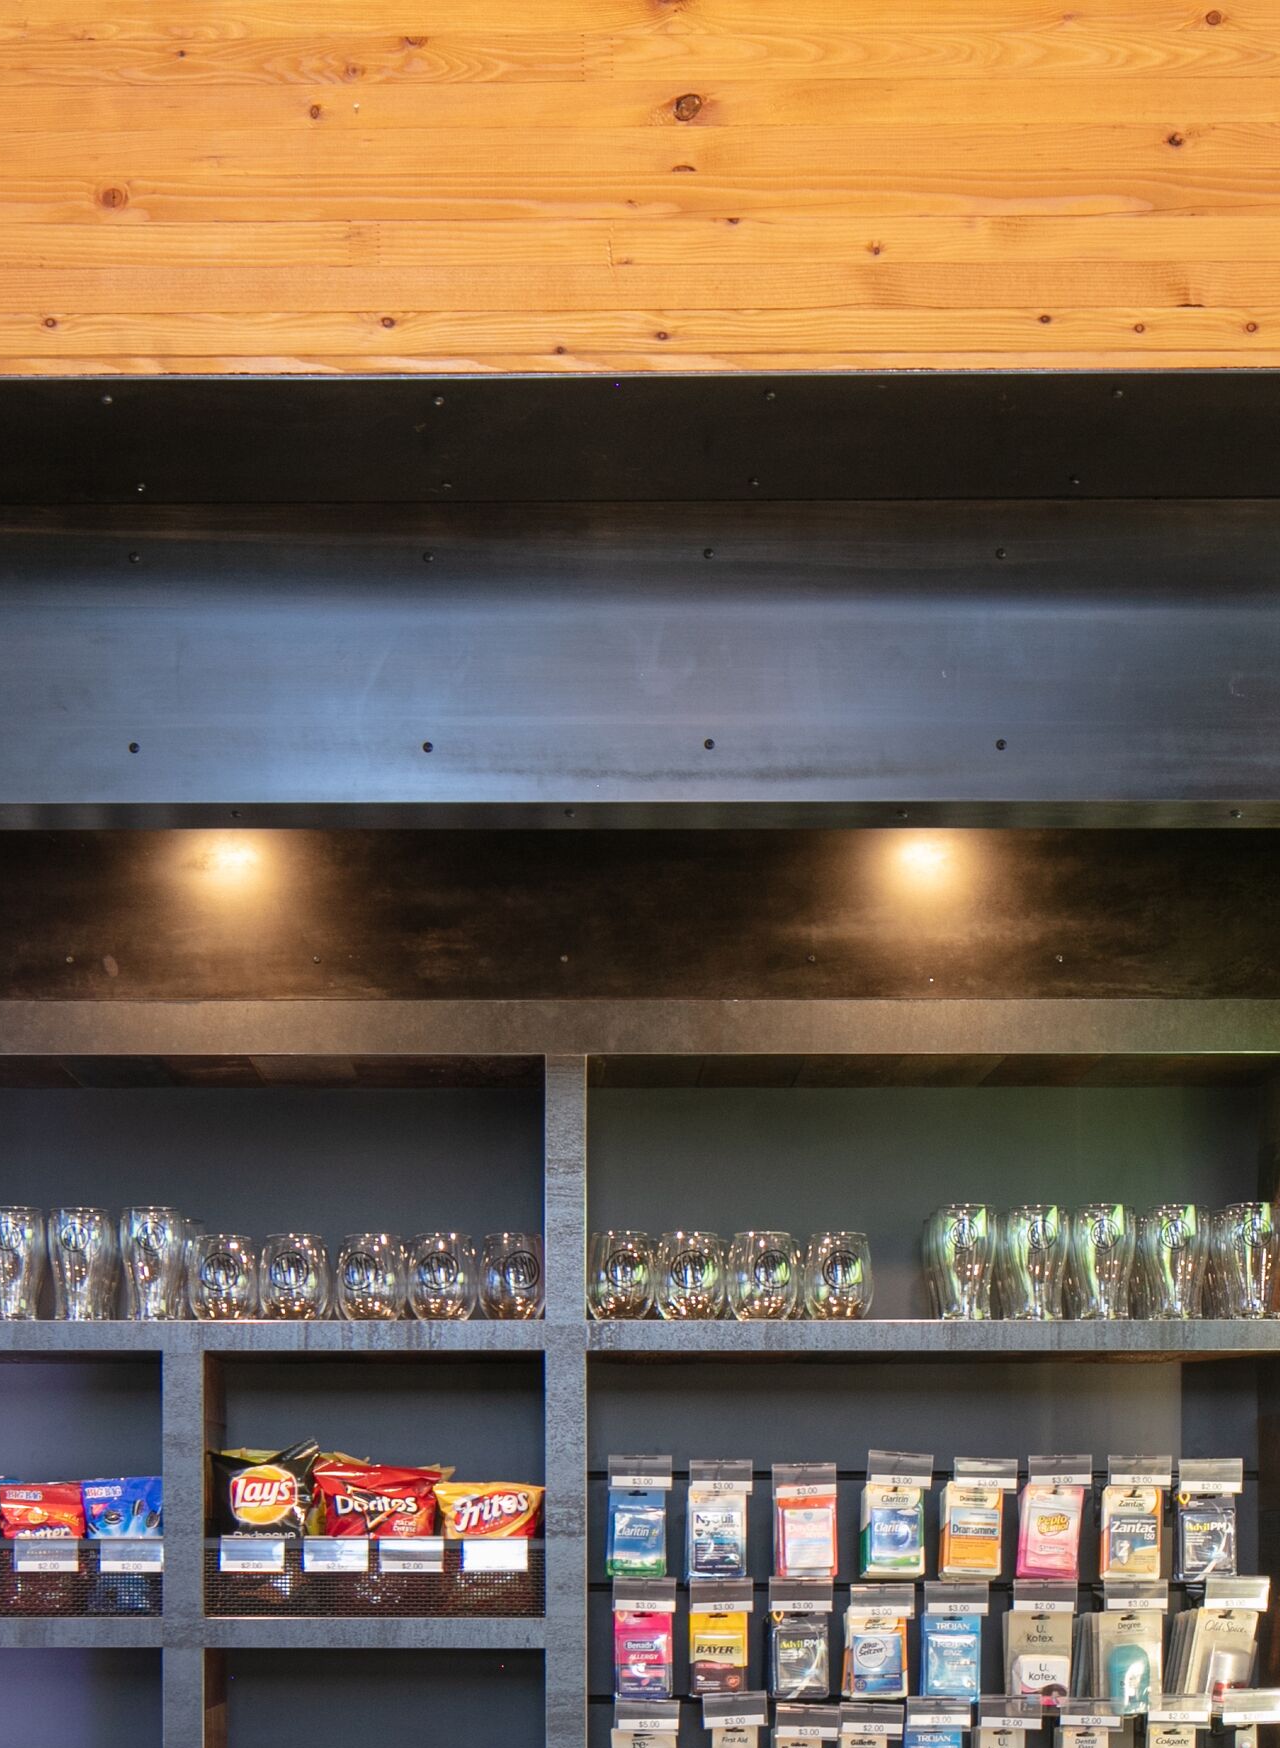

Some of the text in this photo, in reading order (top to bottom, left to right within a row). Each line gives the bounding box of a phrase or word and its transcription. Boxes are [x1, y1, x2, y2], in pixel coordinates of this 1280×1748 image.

[632, 1477, 653, 1486] $3.00
[891, 1477, 913, 1485] $3.00
[1052, 1476, 1073, 1484] $3.00
[1131, 1476, 1153, 1484] $3.00
[6, 1490, 24, 1500] BIG
[85, 1487, 104, 1497] BIG
[797, 1487, 818, 1495] $3.00
[881, 1495, 908, 1503] Claritin
[333, 1493, 417, 1515] Doritos
[455, 1490, 529, 1532] Fritos
[1037, 1514, 1067, 1525] Pepto
[1111, 1521, 1156, 1533] Zantac
[37, 1562, 60, 1571] $2.00
[120, 1562, 142, 1571] $2.00
[240, 1562, 263, 1570] $2.00
[401, 1562, 423, 1570] $2.00
[635, 1602, 657, 1610] $3.00
[713, 1603, 734, 1611] $3.00
[1034, 1602, 1056, 1610] $2.00
[871, 1608, 892, 1616] $3.00
[935, 1622, 971, 1630] TROJAN
[1118, 1621, 1141, 1630] Degree
[696, 1646, 734, 1654] BAYER
[858, 1648, 884, 1656] Seltzer
[1168, 1712, 1190, 1720] $2.00
[724, 1717, 745, 1725] $3.00
[1001, 1718, 1023, 1727] $2.00
[1081, 1716, 1102, 1725] $2.00
[798, 1728, 820, 1736] $3.00
[863, 1724, 884, 1733] $2.00
[850, 1739, 877, 1747] Gillette
[1156, 1737, 1189, 1746] Colgate
